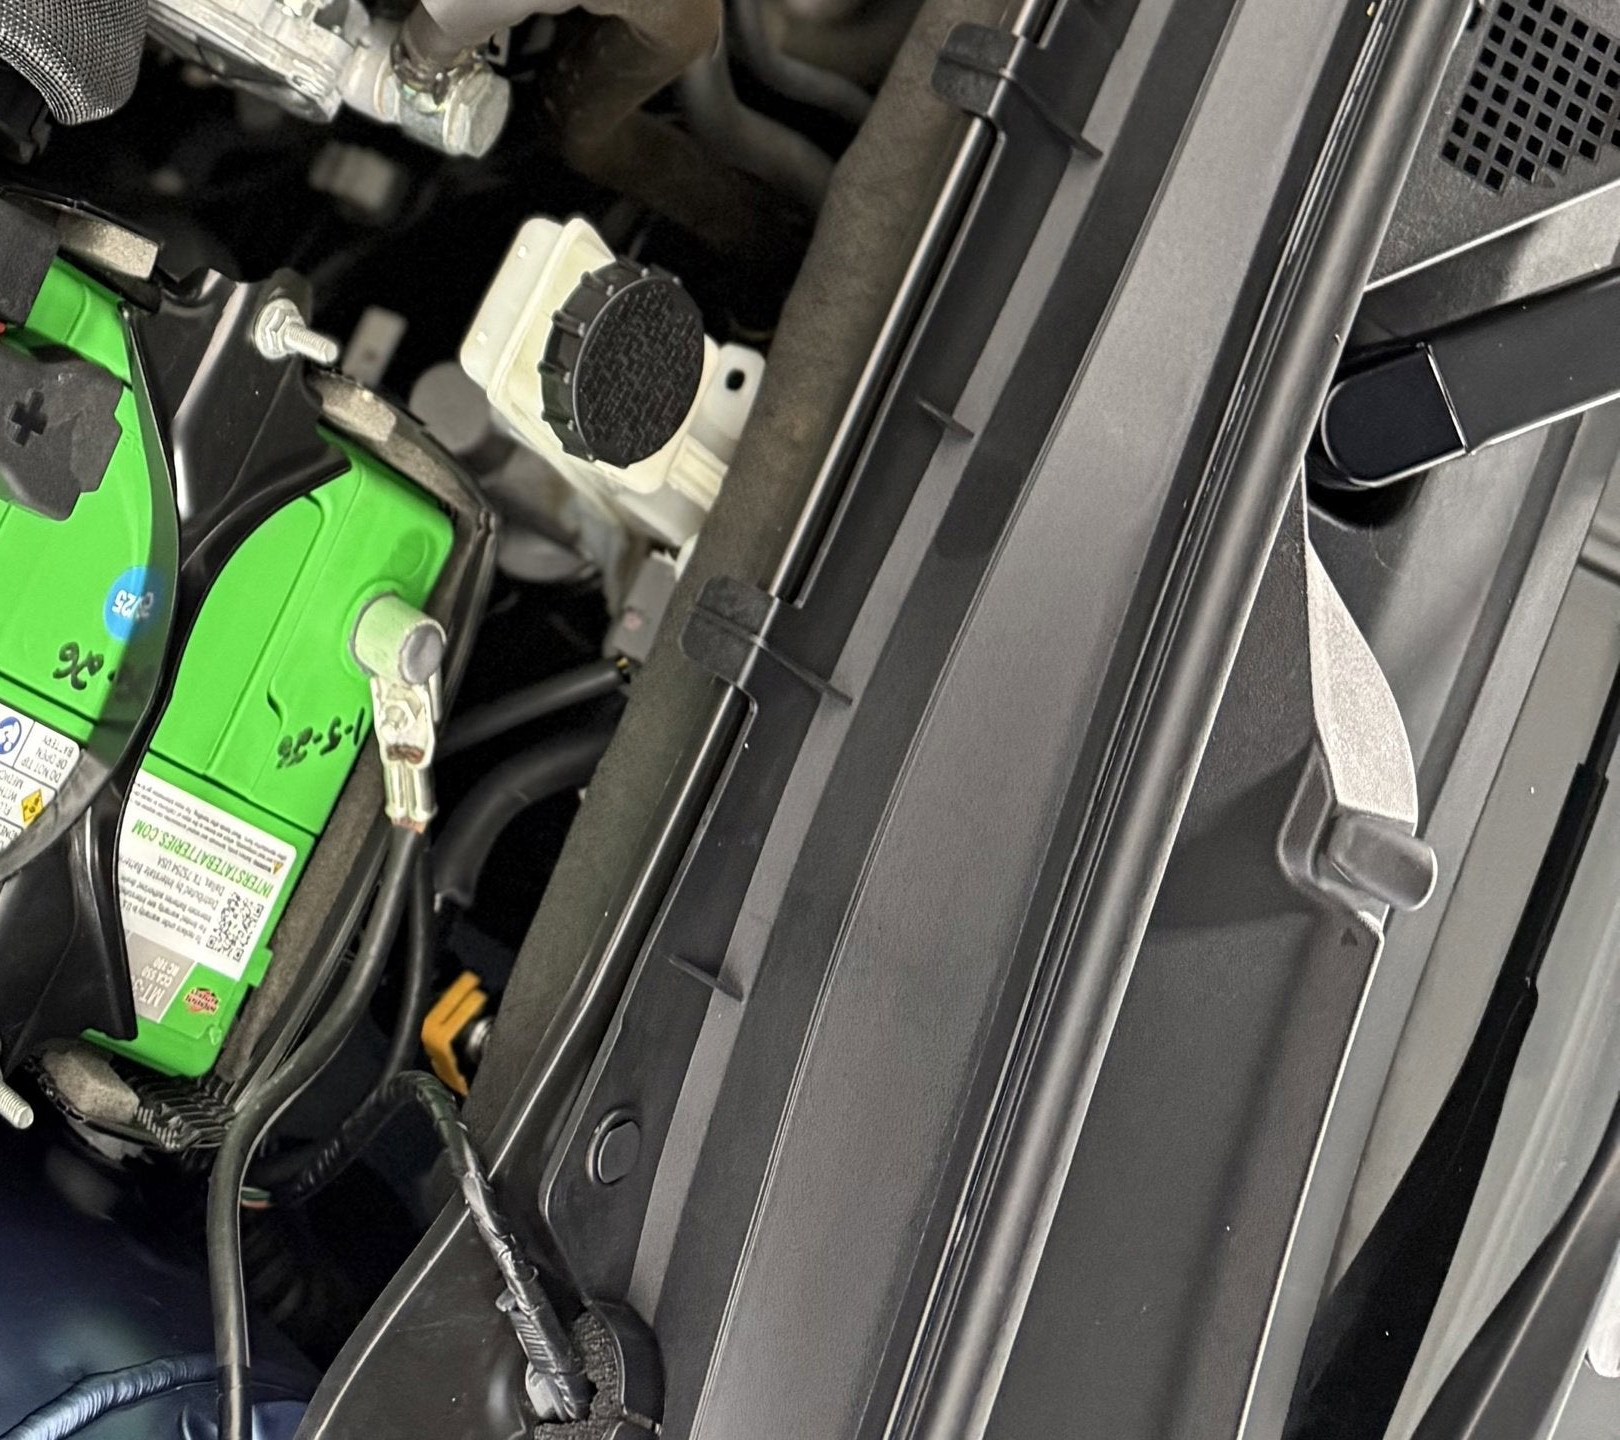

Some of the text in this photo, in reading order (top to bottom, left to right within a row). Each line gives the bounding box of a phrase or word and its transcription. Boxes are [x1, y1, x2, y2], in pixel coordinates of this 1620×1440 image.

[43, 735, 74, 758] BATTERY
[277, 708, 372, 768] 1-5-26
[20, 756, 62, 784] DO NOT TIP
[35, 747, 68, 770] OR OPEN
[132, 820, 273, 897] INTERSTATEBATTERIES.COM
[154, 854, 172, 872] USA
[143, 866, 175, 889] Interstate
[192, 873, 202, 886] TX
[180, 884, 219, 910] Distributed
[139, 962, 174, 987] CCA 550
[164, 960, 180, 978] RC
